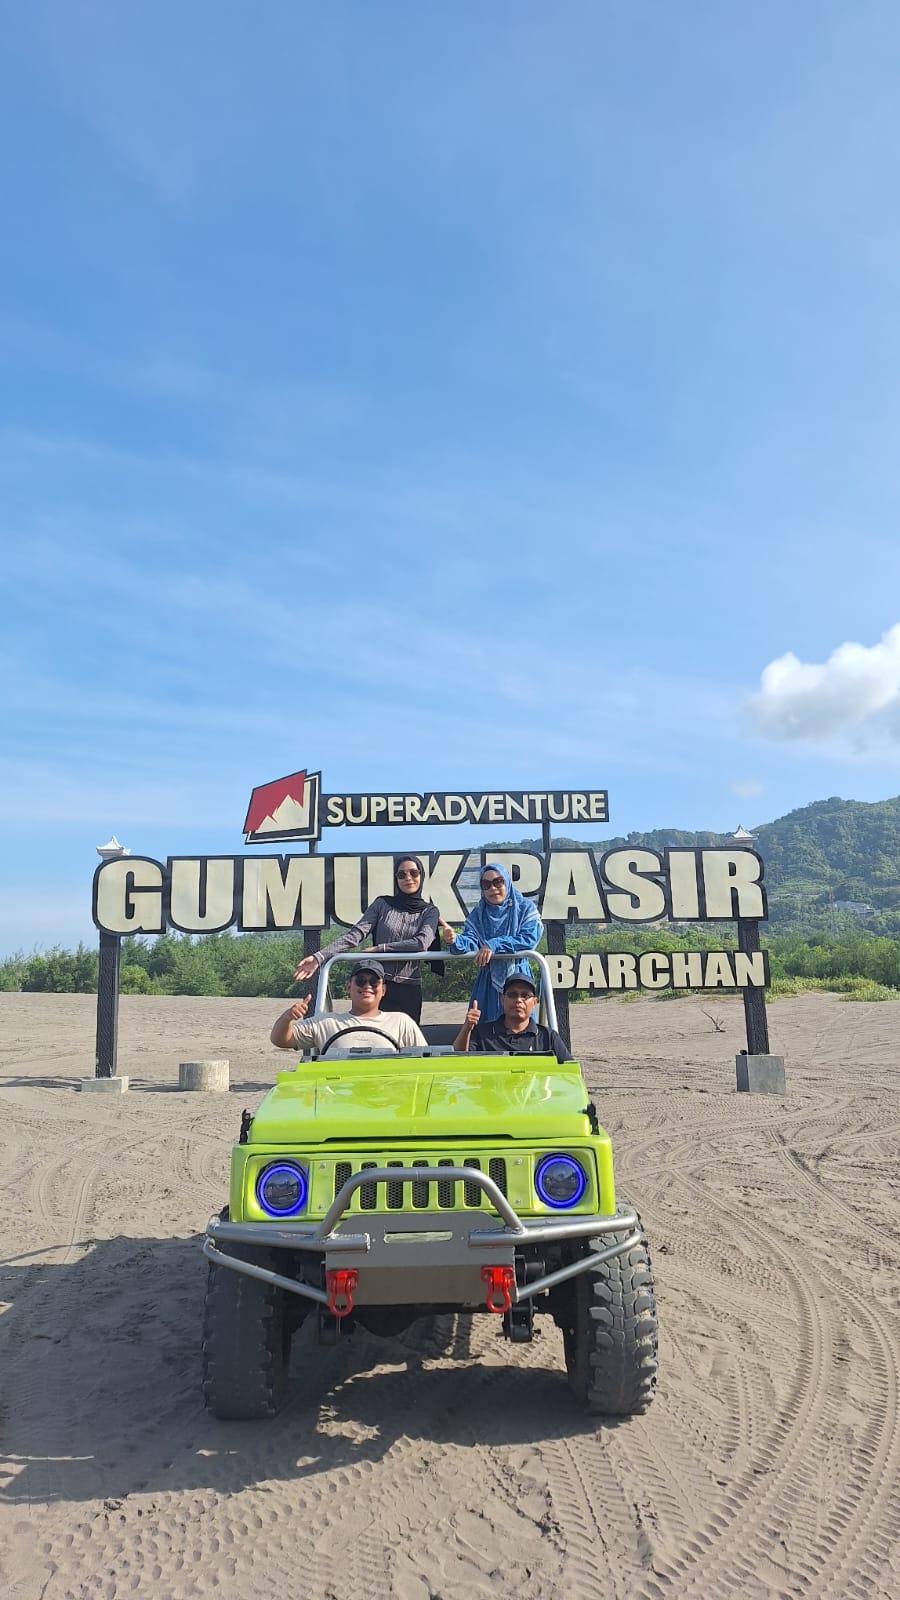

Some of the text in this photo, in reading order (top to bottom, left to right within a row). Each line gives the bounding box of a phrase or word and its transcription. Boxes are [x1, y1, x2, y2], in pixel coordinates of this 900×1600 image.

[326, 793, 606, 824] SUPERADVENTURE
[97, 849, 764, 932] GUMUK PASIR
[547, 952, 766, 989] BARCHAN
